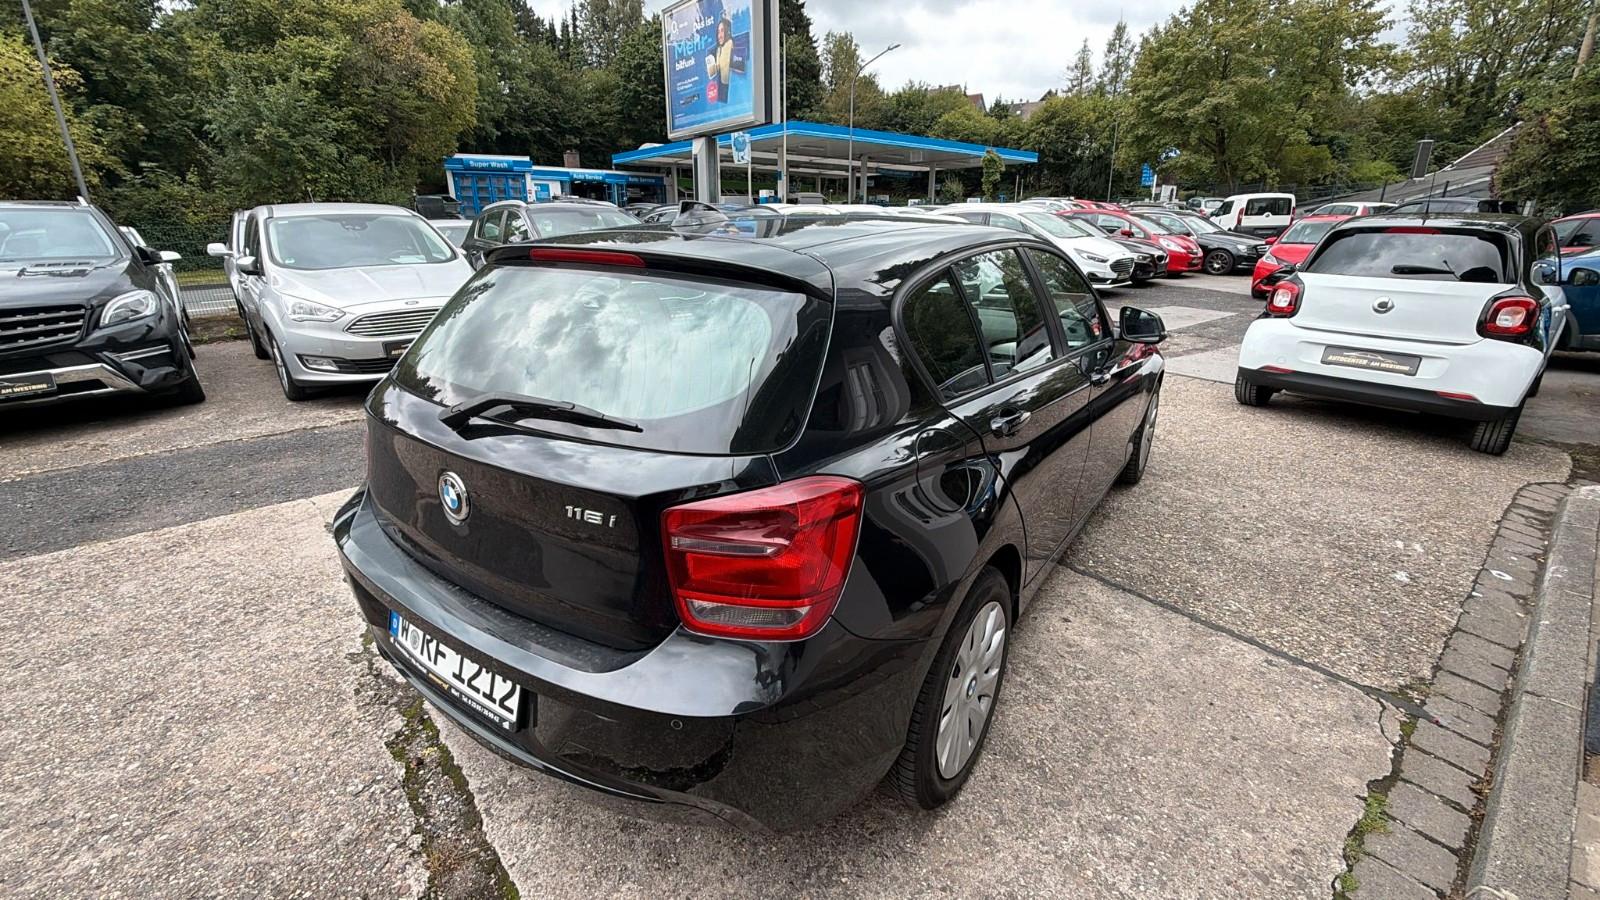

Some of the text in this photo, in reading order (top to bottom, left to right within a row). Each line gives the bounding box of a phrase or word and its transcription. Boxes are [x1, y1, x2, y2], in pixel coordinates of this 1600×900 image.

[705, 15, 714, 26] ist
[674, 34, 713, 59] Mehr-
[469, 160, 508, 169] Super Wash
[1327, 355, 1368, 365] AUTOCENTER
[452, 652, 518, 715] 1212
